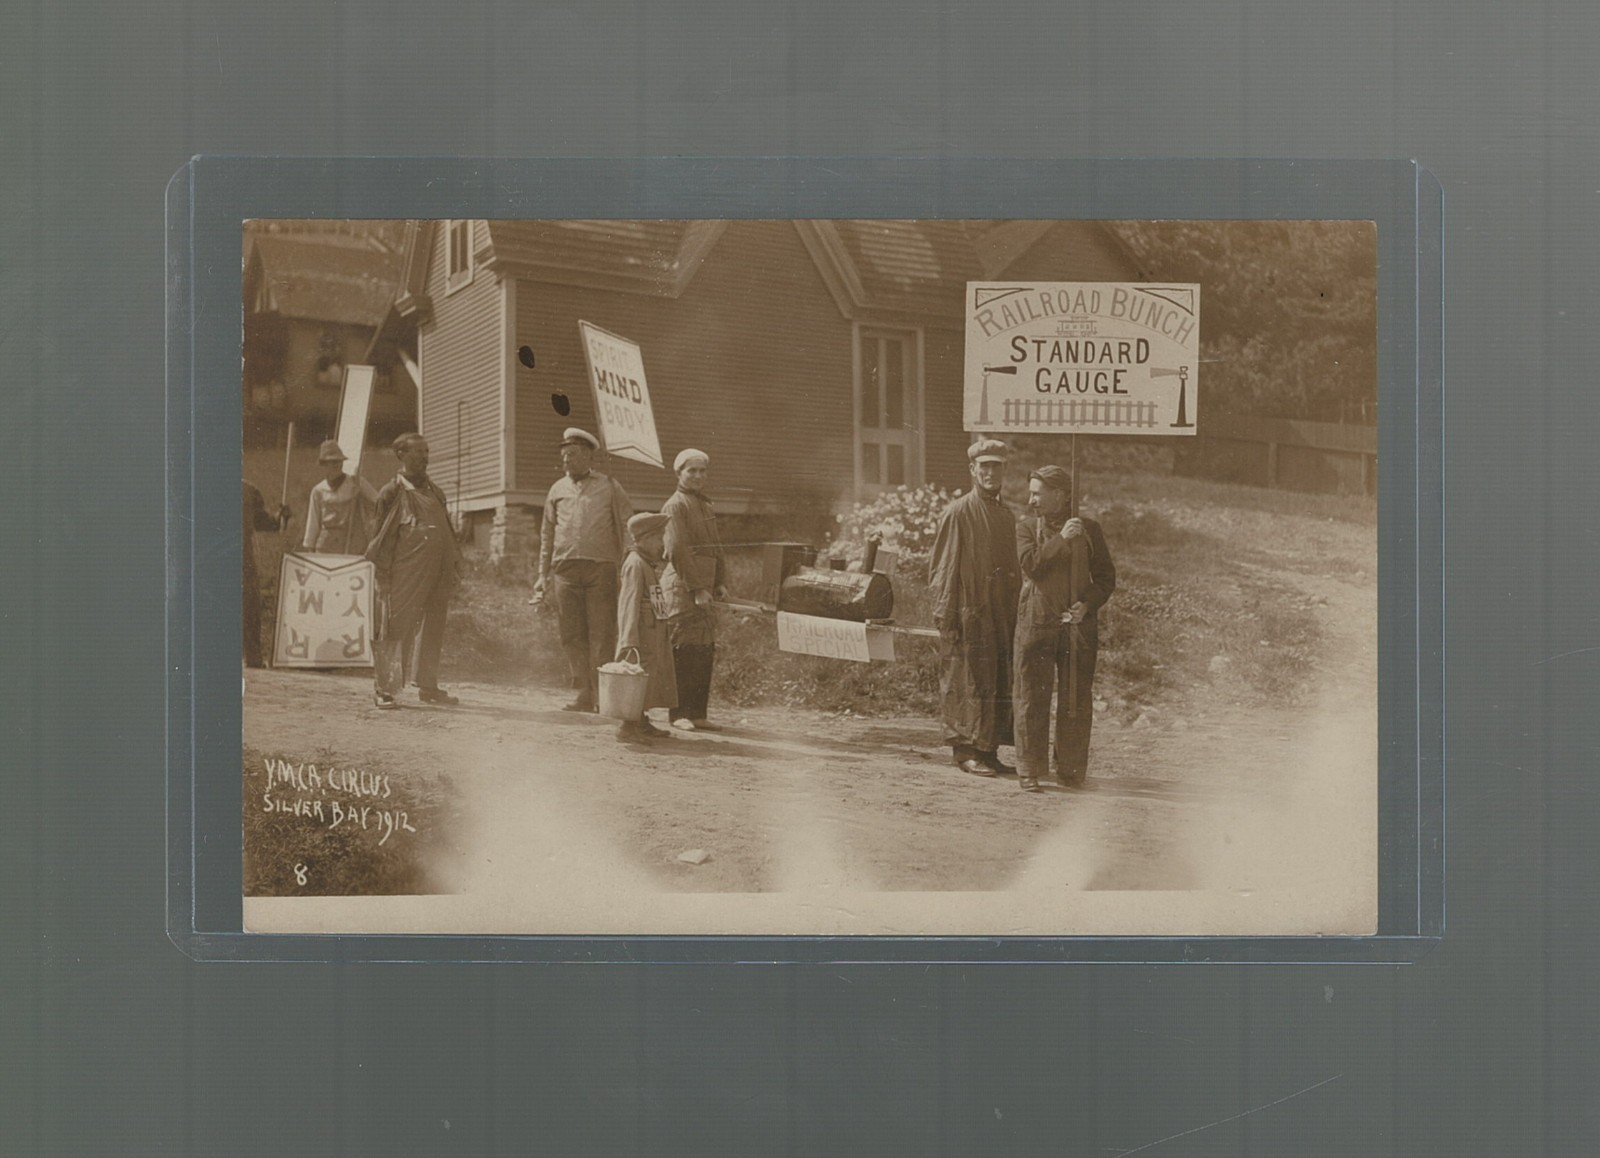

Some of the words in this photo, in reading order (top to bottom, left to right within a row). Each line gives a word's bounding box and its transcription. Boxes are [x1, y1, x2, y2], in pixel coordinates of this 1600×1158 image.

[974, 289, 1100, 337] RAILROAD
[1110, 288, 1196, 344] BUNCH
[1010, 335, 1150, 364] STANDARD
[1035, 367, 1129, 394] GAUGE
[790, 634, 865, 659] SPECIAL
[328, 767, 391, 799] CIRCUS
[263, 794, 324, 822] SILVER
[329, 801, 371, 829] BAY
[376, 811, 416, 846] 1912
[294, 863, 308, 886] 8
